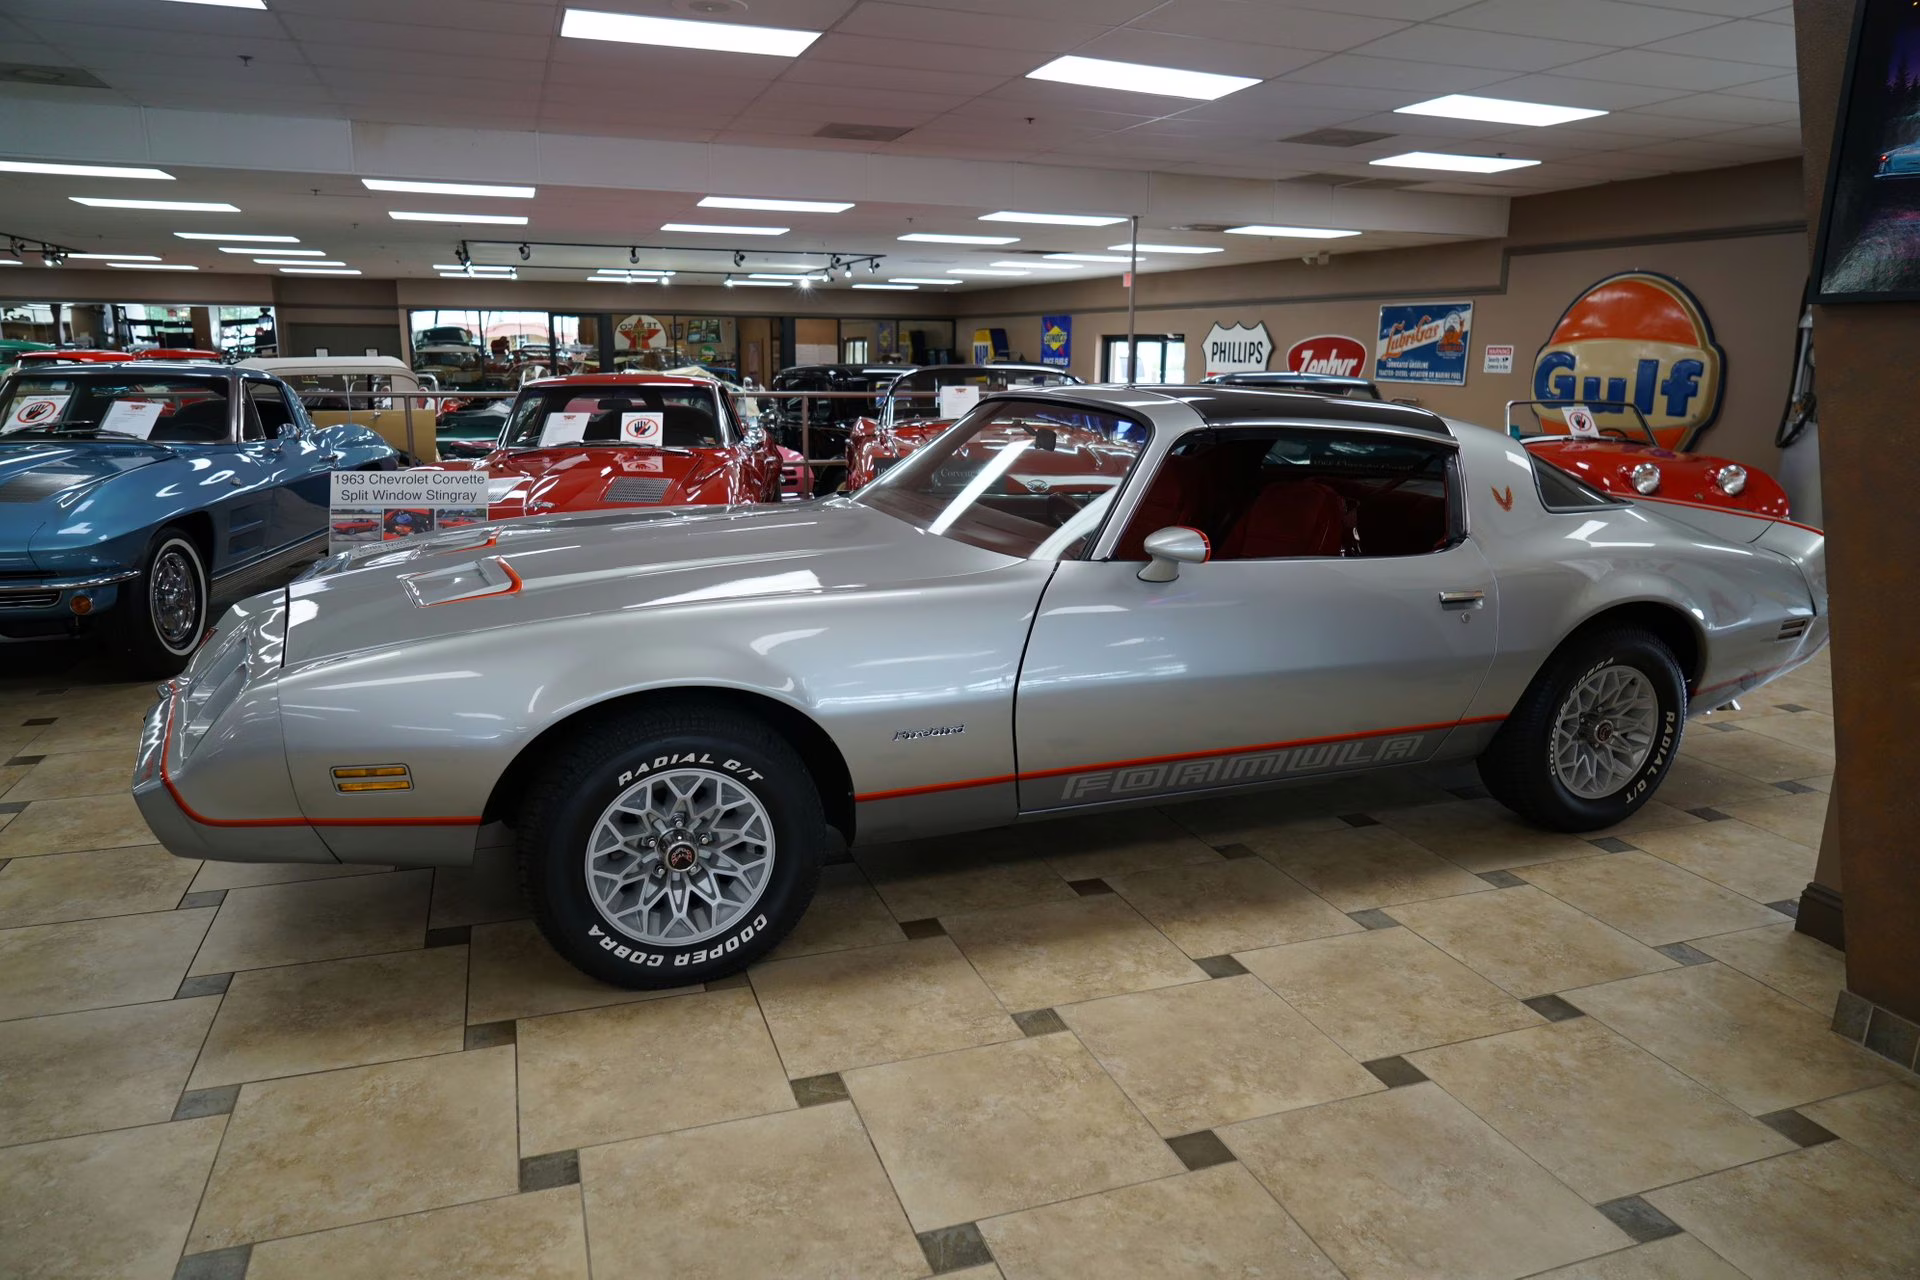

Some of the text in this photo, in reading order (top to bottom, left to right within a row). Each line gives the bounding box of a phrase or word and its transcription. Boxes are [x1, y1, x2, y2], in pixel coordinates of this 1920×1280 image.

[1211, 341, 1263, 364] PHILLIPS
[1299, 348, 1358, 377] Zephyr
[1534, 351, 1704, 417] Gulf
[334, 474, 485, 485] 1963 Chevrolet Corvette
[341, 490, 477, 502] Split Window Stingray
[892, 725, 965, 741] Firebird
[618, 753, 764, 787] RADIAL G/T
[1061, 735, 1425, 800] FORMULA
[1625, 711, 1676, 804] RADIAL G/T
[588, 914, 768, 967] COOPER COBRA
